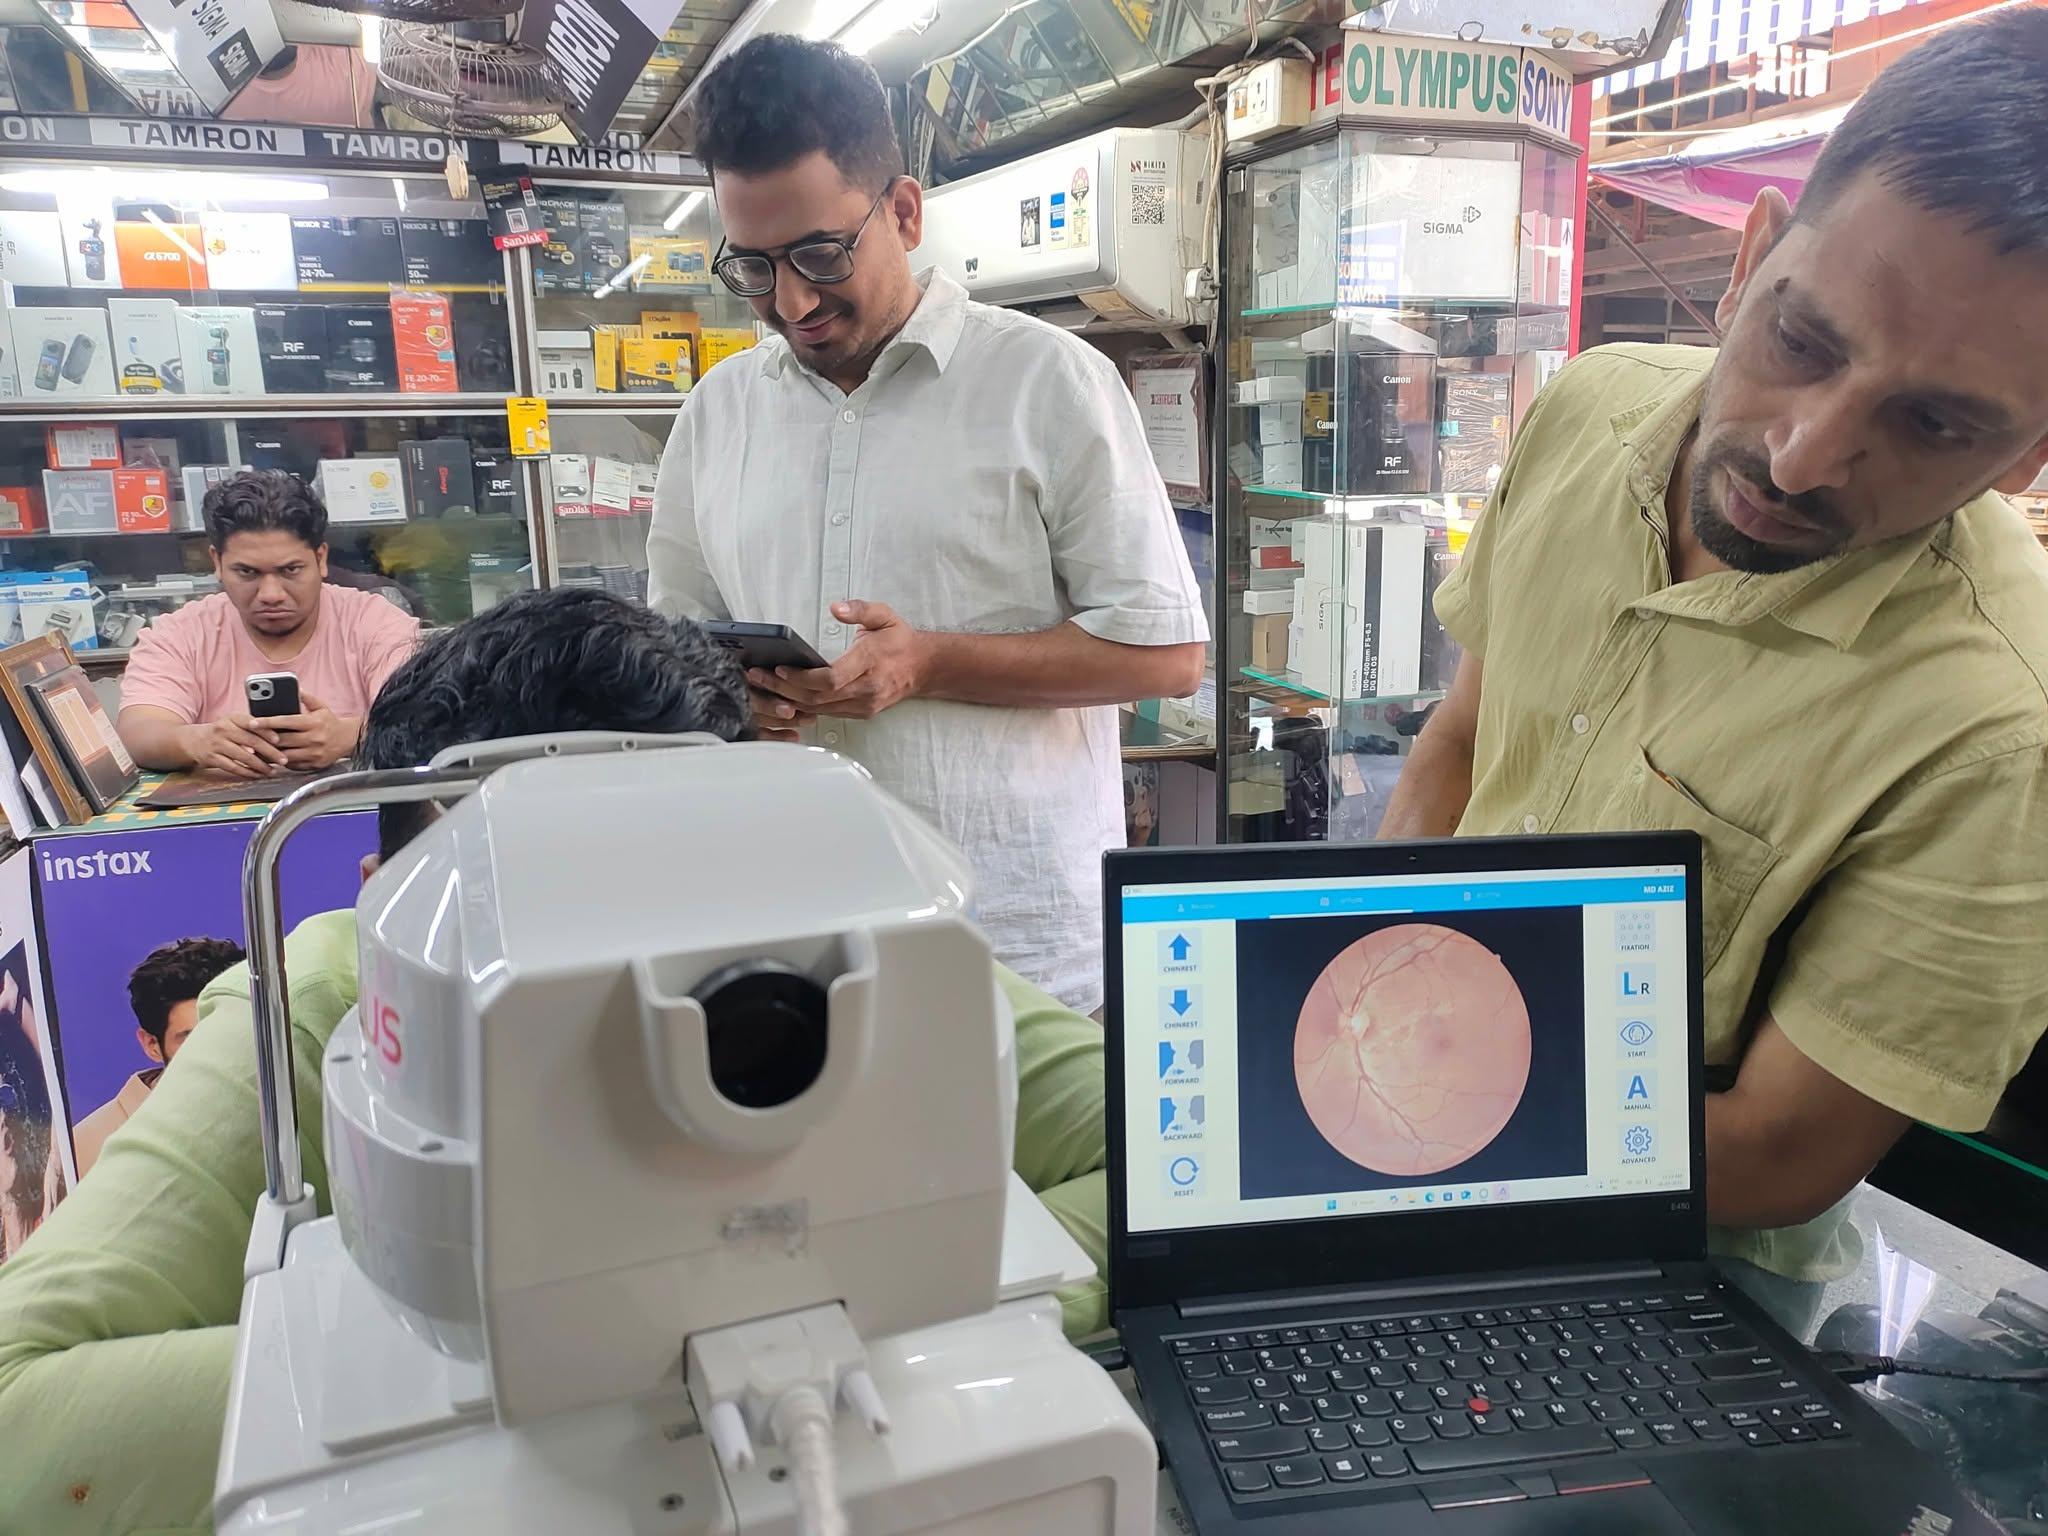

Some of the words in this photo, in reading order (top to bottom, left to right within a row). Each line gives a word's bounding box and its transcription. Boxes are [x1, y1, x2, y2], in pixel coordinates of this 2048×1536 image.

[219, 41, 251, 80] SIGMA
[546, 0, 620, 113] AMRON
[1349, 43, 1518, 115] OLYMPUS
[1522, 59, 1572, 133] SONY
[120, 121, 278, 152] TAMRON
[323, 133, 469, 161] TAMRON
[525, 144, 657, 172] TAMRON
[1423, 222, 1464, 234] SIGMA
[502, 232, 543, 248] SanDisk
[283, 342, 304, 352] RF
[358, 373, 374, 381] RF
[1383, 376, 1411, 384] Canon
[1317, 420, 1338, 429] Canon
[1385, 457, 1402, 467] RF
[492, 480, 511, 489] RF
[53, 492, 111, 516] AF
[558, 505, 590, 514] SanDisk
[1371, 656, 1377, 667] OS
[1363, 648, 1371, 691] 100-400mm
[1371, 668, 1377, 679] DN
[43, 848, 153, 882] instax
[1643, 885, 1656, 894] MD
[1623, 972, 1637, 995] L
[1641, 983, 1650, 995] R
[1164, 1021, 1198, 1029] CHINREST
[1165, 1077, 1200, 1086] FORWARD
[1627, 1075, 1648, 1100] A
[1624, 1103, 1651, 1111] MANUAL
[1163, 1132, 1203, 1141] BACKWARD
[1622, 1156, 1656, 1165] ADVANCED
[1174, 1189, 1194, 1197] RESET
[1303, 1356, 1312, 1364] 3
[1254, 1378, 1266, 1387] Q
[1293, 1374, 1307, 1383] W
[1331, 1370, 1343, 1379] E
[1370, 1367, 1382, 1375] R
[1408, 1362, 1418, 1371] T
[1446, 1359, 1456, 1368] Y
[1483, 1356, 1495, 1365] U
[1558, 1348, 1570, 1357] O
[1594, 1345, 1603, 1354] P
[1207, 1410, 1245, 1420] CapsLock
[1279, 1402, 1289, 1412] A
[1317, 1398, 1328, 1408] S
[1356, 1394, 1368, 1403] D
[1395, 1390, 1405, 1399] F
[1436, 1387, 1448, 1396] G
[1474, 1383, 1486, 1392] H
[1514, 1380, 1522, 1389] J
[1550, 1375, 1562, 1385] K
[1587, 1372, 1599, 1381] L
[1312, 1428, 1323, 1438] Z
[1353, 1424, 1365, 1433] X
[1393, 1420, 1405, 1429] C
[1433, 1415, 1443, 1425] V
[1474, 1415, 1486, 1424] B
[1512, 1408, 1525, 1417] N
[1551, 1404, 1566, 1413] M
